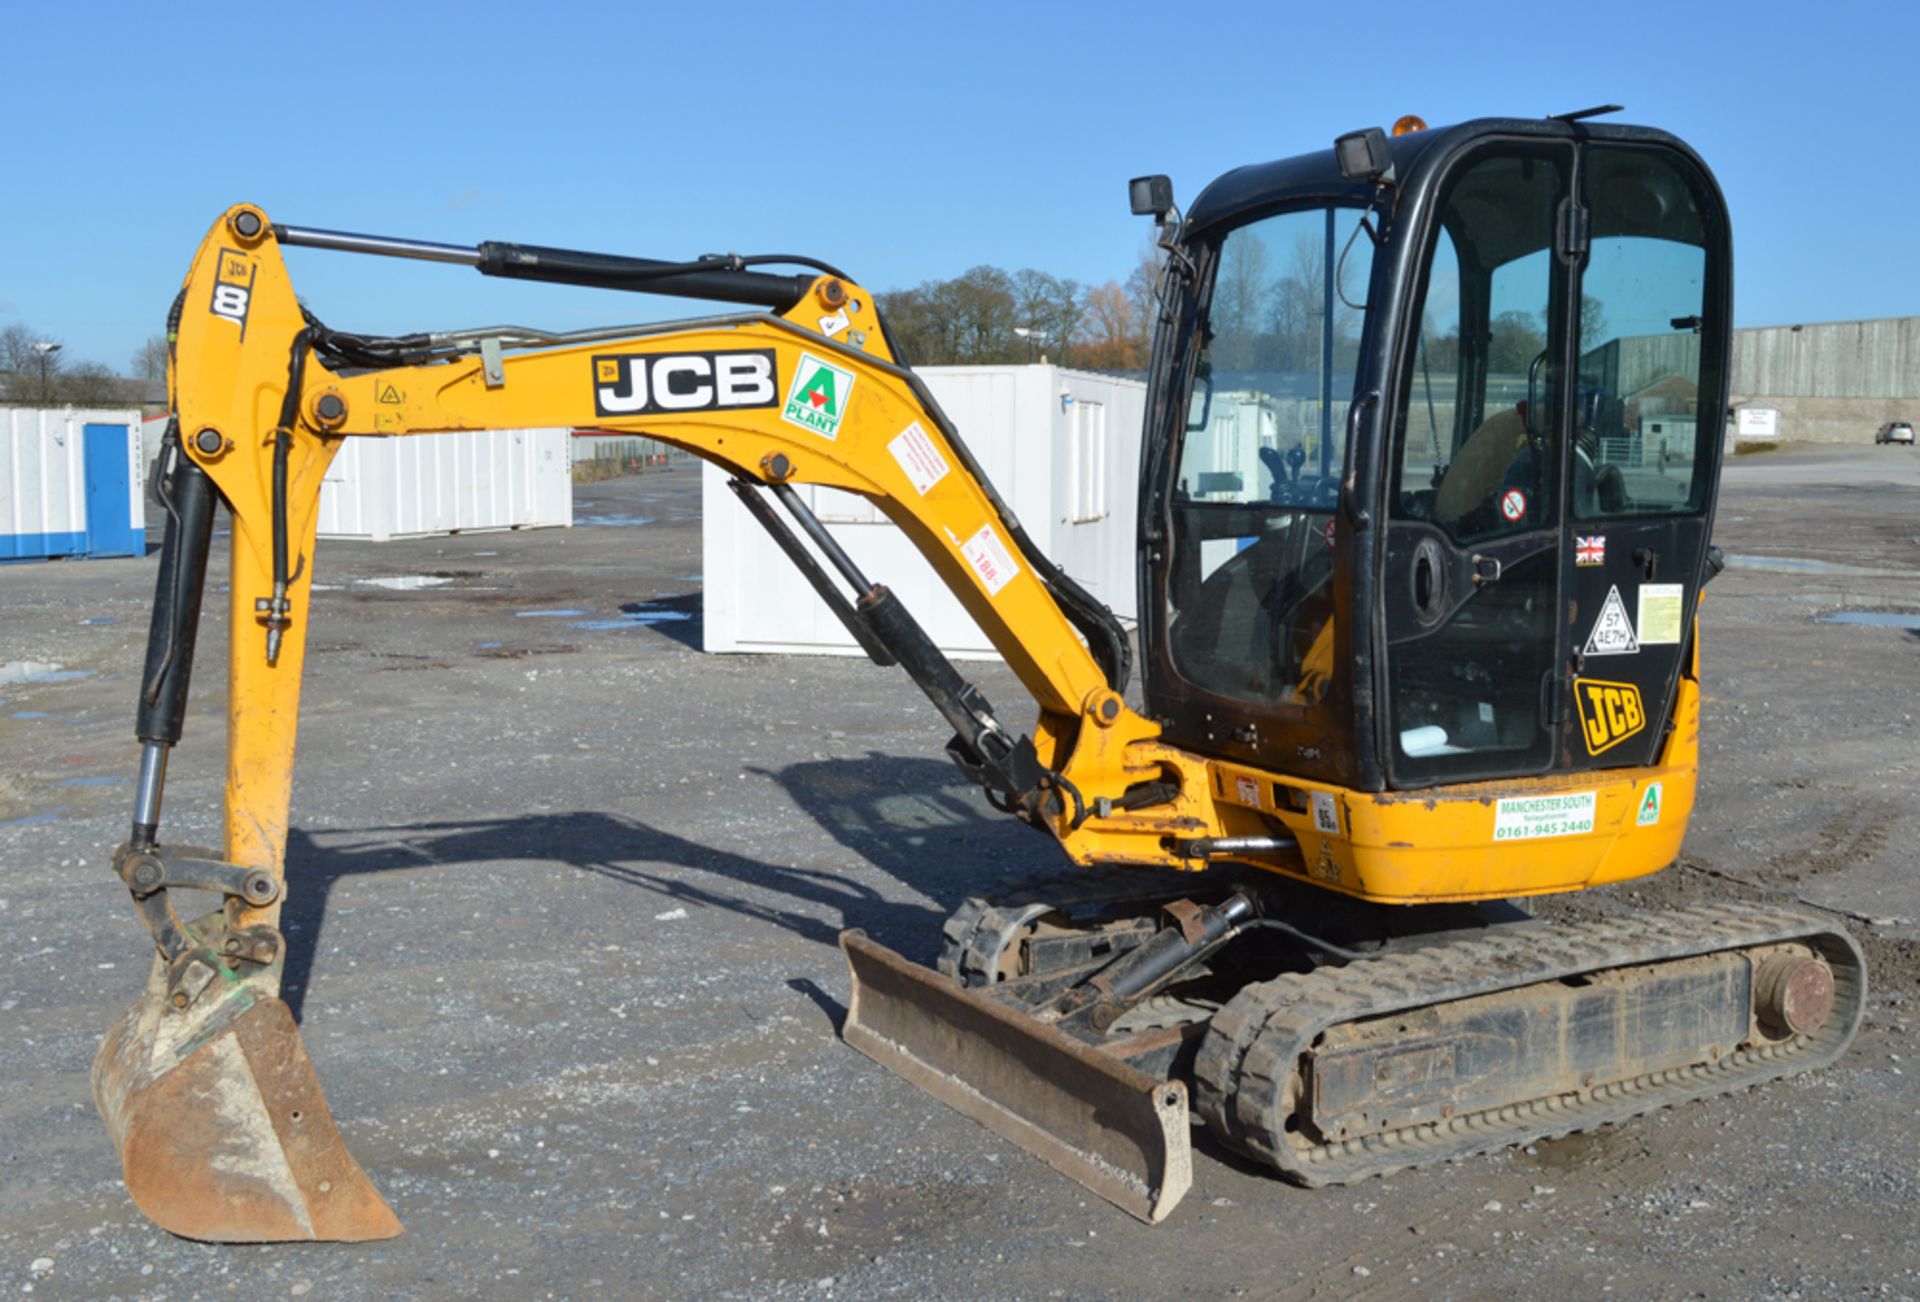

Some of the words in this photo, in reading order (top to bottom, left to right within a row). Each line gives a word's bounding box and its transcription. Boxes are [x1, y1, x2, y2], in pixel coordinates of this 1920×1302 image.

[599, 354, 775, 412] JCB
[795, 367, 837, 417] A
[786, 404, 838, 433] PLANT
[1587, 686, 1641, 746] JCB
[1501, 798, 1561, 814] MANCHESTER
[1562, 795, 1592, 809] SOUTH
[1497, 822, 1558, 838] 0161-945
[1561, 819, 1591, 833] 2440
